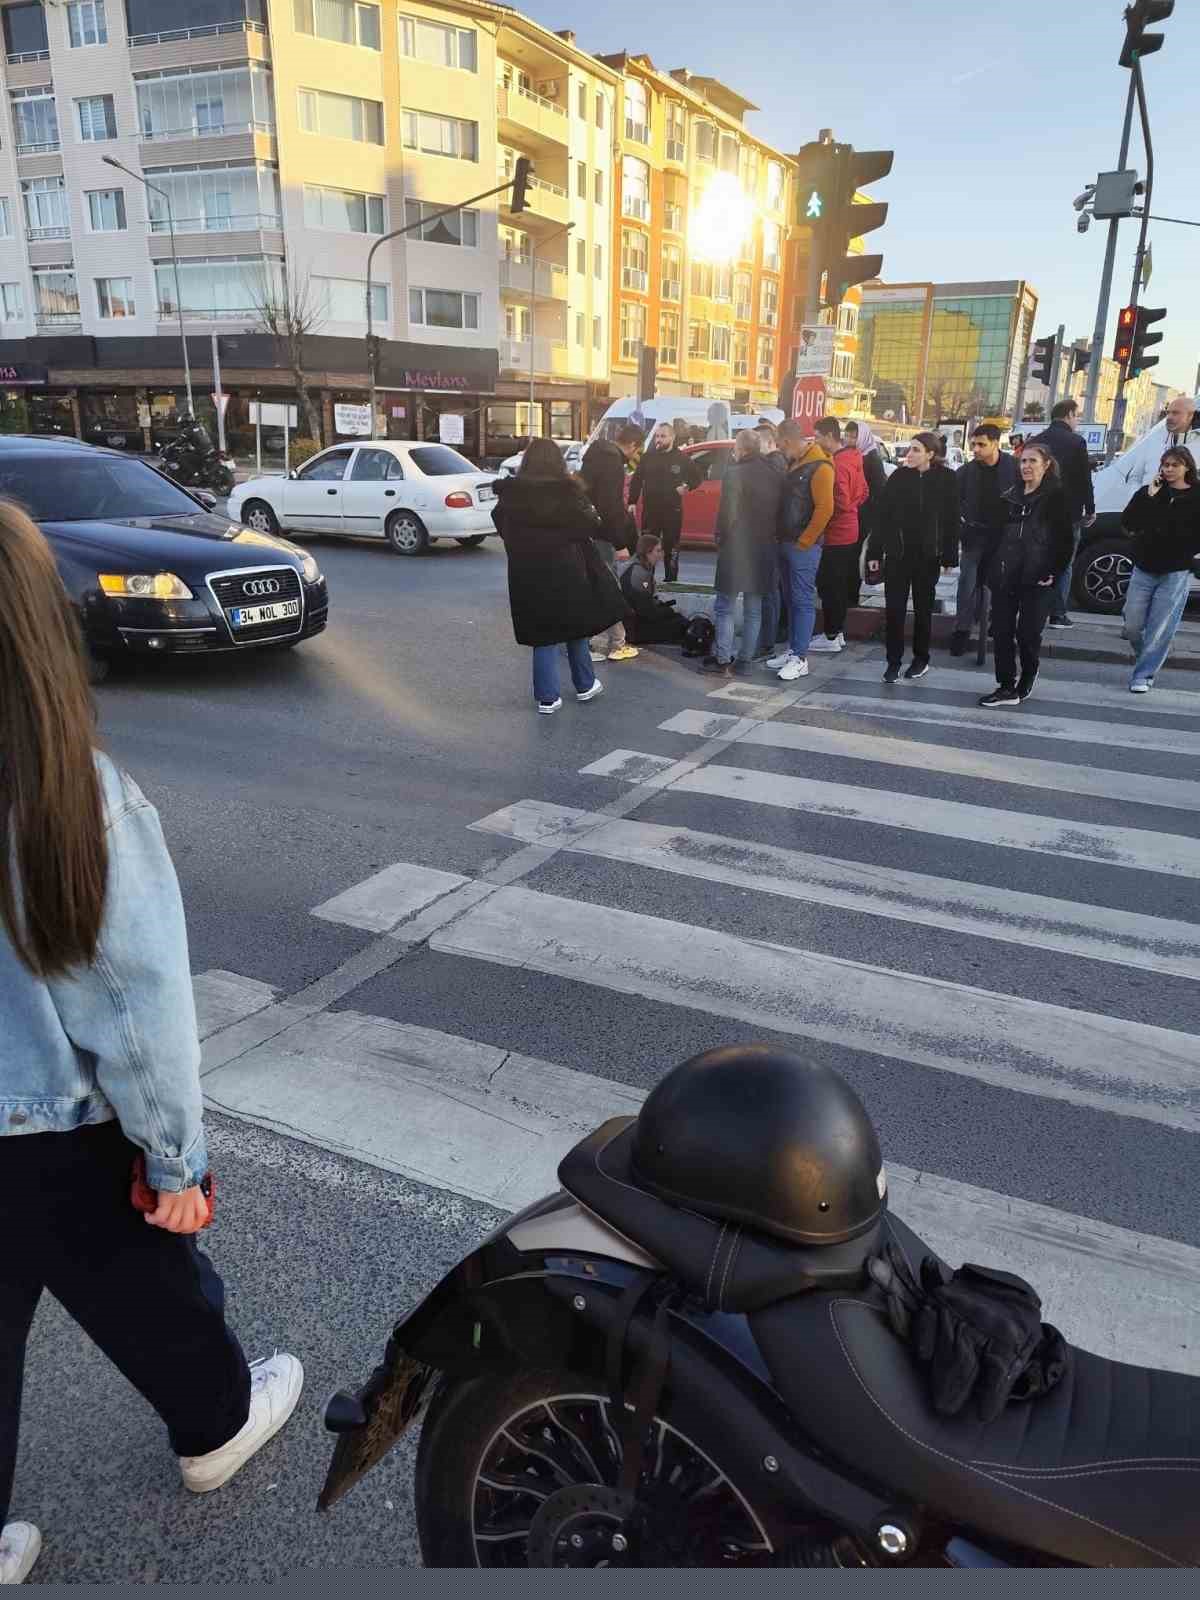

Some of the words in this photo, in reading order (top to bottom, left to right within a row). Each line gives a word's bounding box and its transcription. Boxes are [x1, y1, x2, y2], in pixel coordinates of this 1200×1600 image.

[795, 390, 825, 417] DUR
[241, 609, 253, 623] 34
[259, 606, 277, 620] NOL
[282, 601, 298, 616] 300
